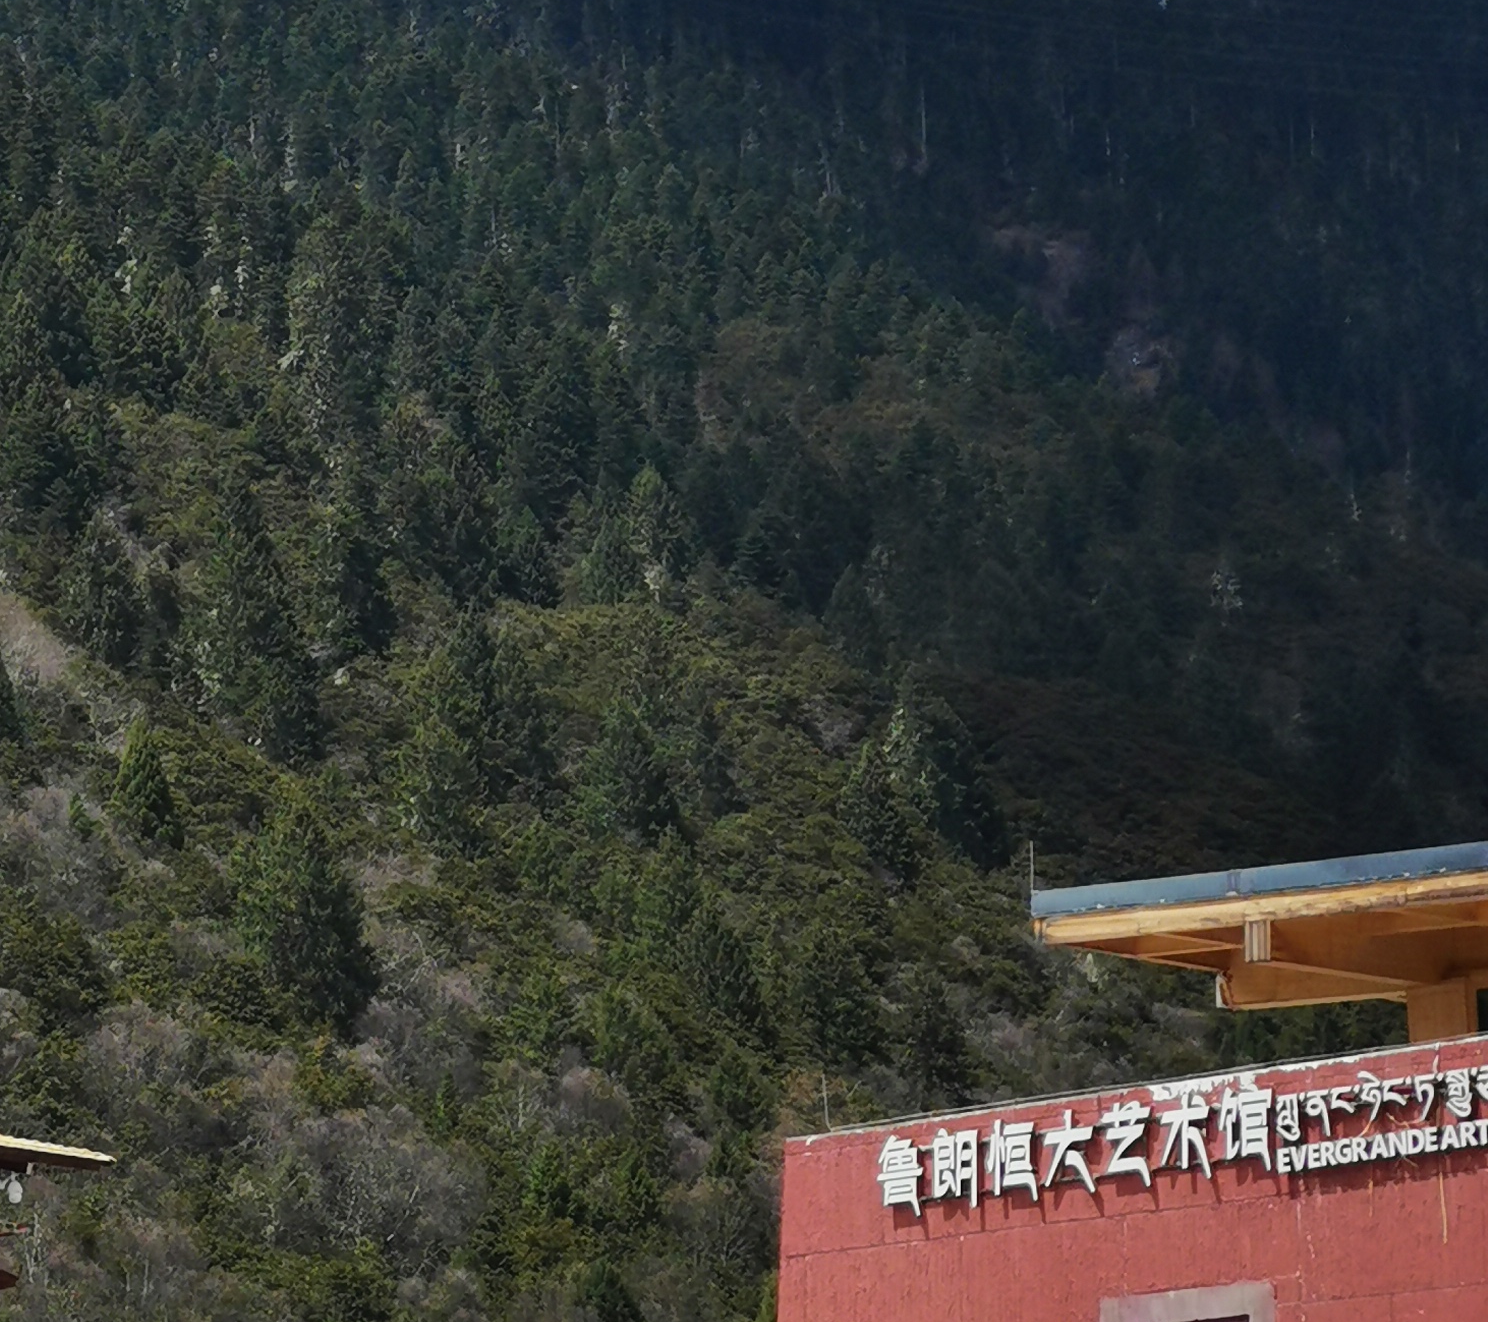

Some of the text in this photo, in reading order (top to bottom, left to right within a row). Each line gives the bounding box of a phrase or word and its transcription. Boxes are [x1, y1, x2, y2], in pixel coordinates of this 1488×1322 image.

[877, 1087, 1273, 1217] 鲁朗恒大艺术馆
[1276, 1119, 1488, 1174] EVERGRANDE ART
